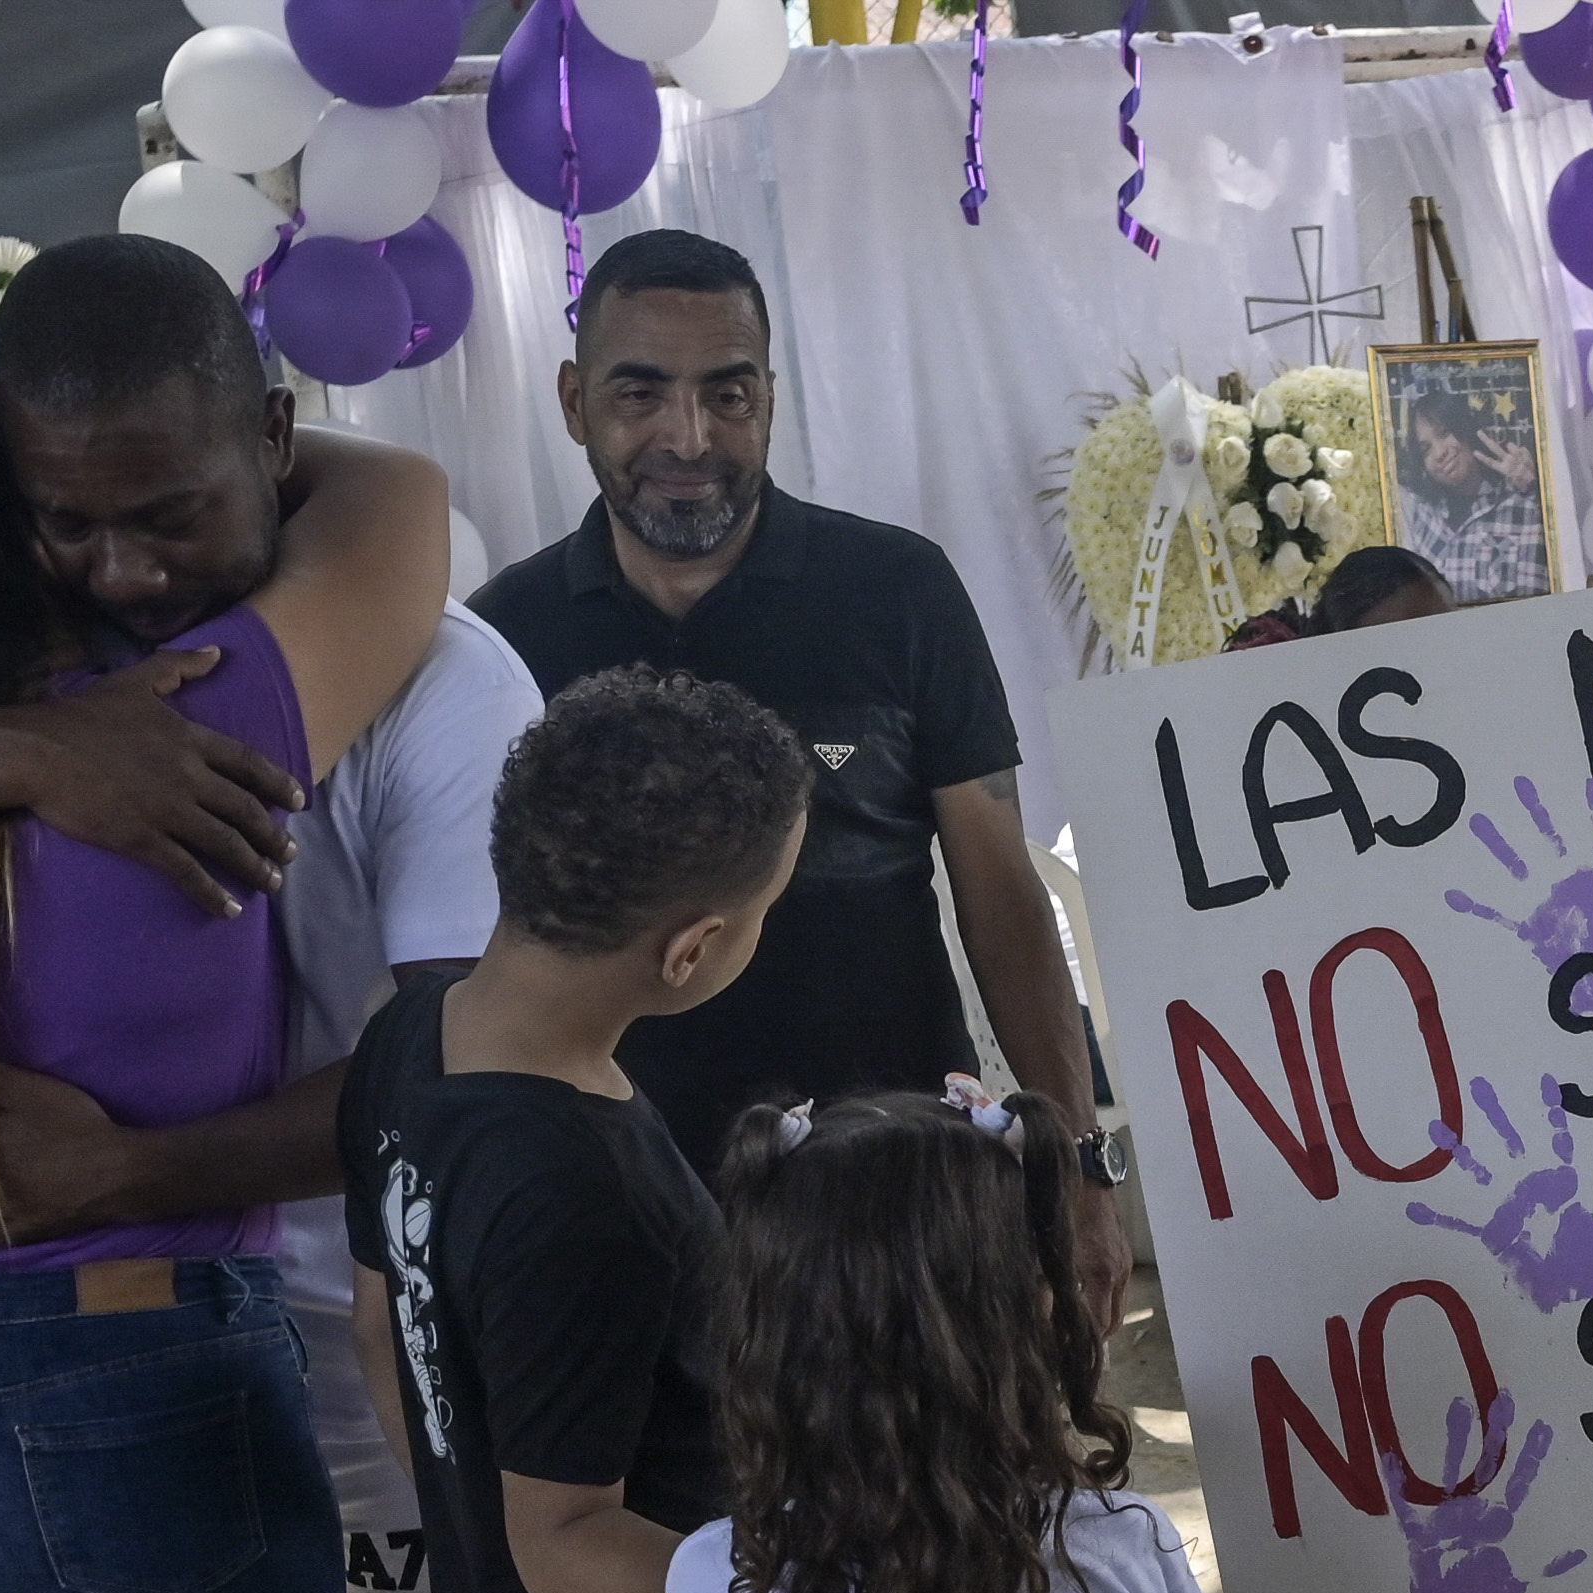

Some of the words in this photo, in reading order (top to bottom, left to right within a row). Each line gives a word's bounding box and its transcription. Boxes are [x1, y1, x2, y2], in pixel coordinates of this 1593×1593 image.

[1131, 504, 1171, 658] JUNTA
[1154, 666, 1467, 912] LAS
[1165, 926, 1464, 1221] NO
[1250, 1279, 1508, 1538] NO
